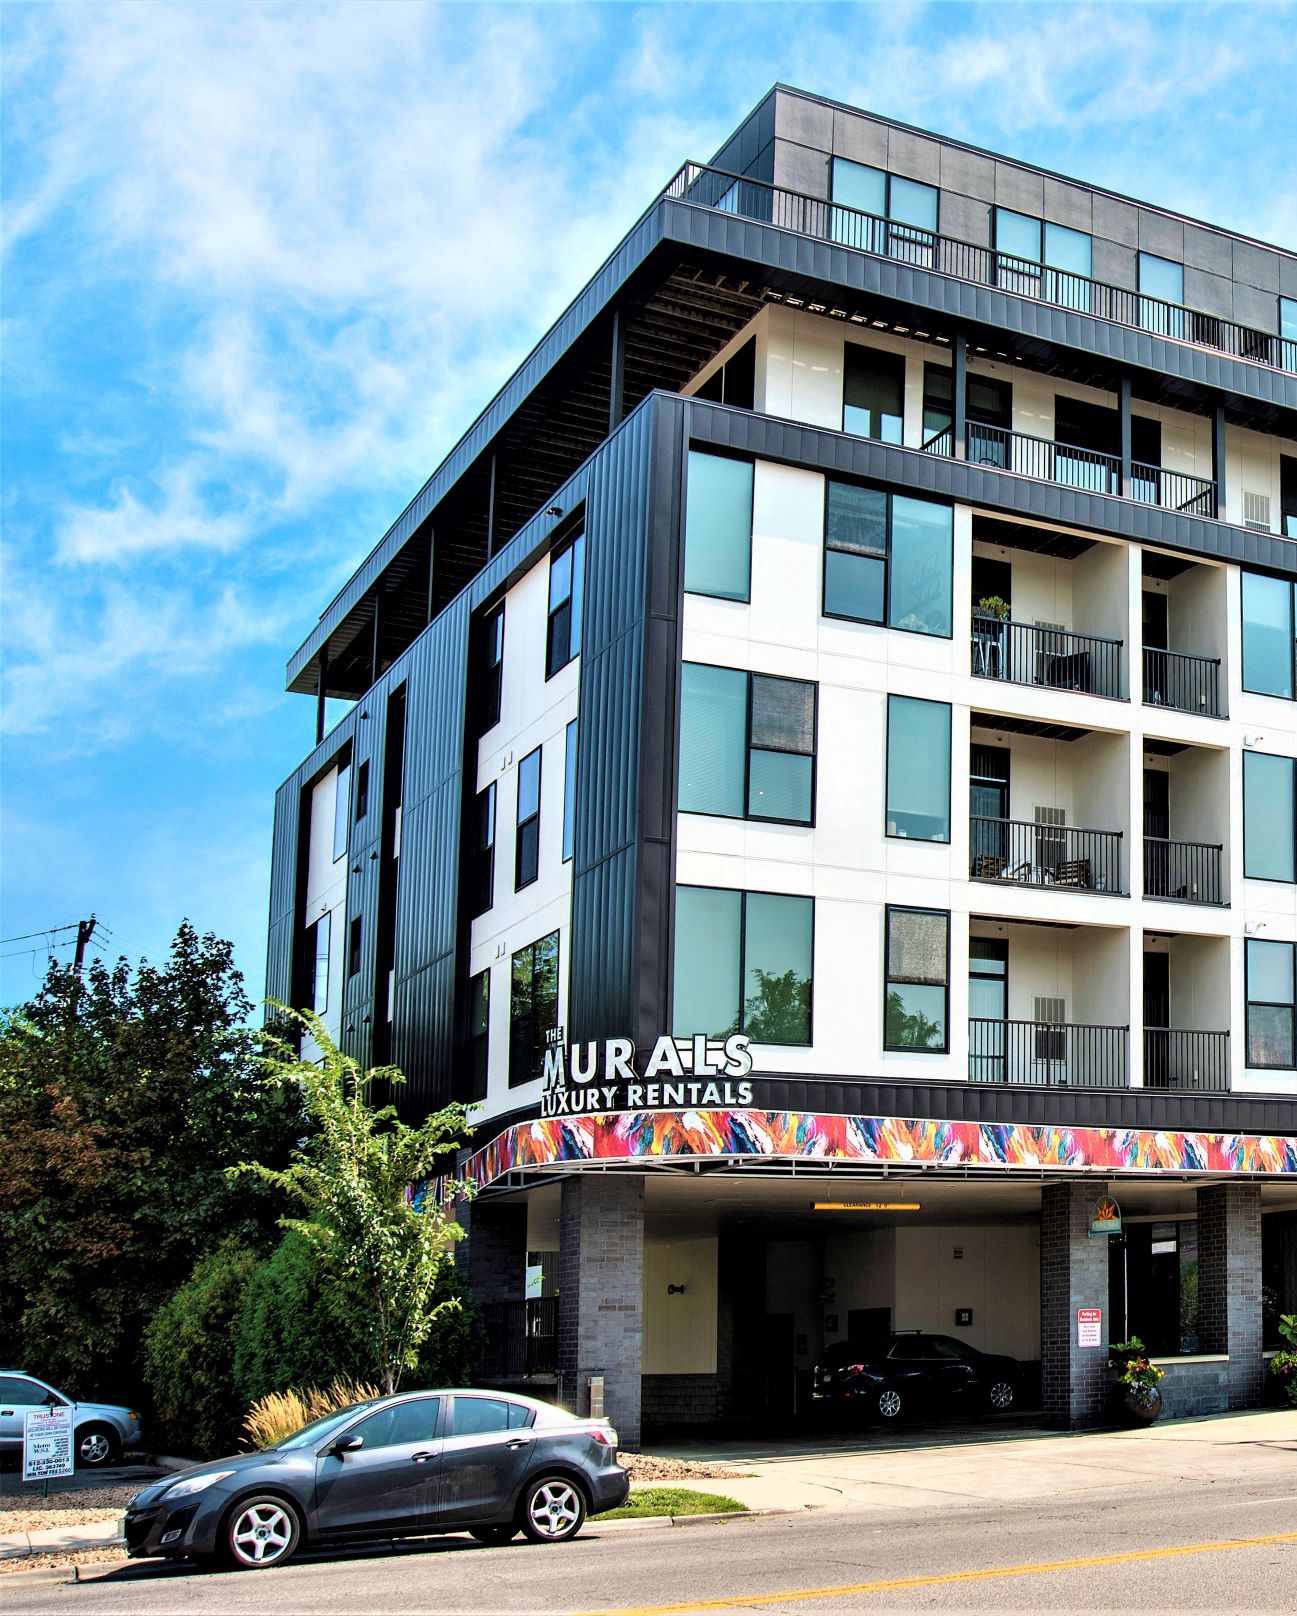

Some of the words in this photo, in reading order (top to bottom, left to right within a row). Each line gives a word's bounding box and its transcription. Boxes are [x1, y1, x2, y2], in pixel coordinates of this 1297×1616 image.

[545, 1026, 562, 1043] THE
[542, 1033, 754, 1093] MURALS
[540, 1085, 618, 1118] LUXURY
[627, 1081, 754, 1108] RENTALS
